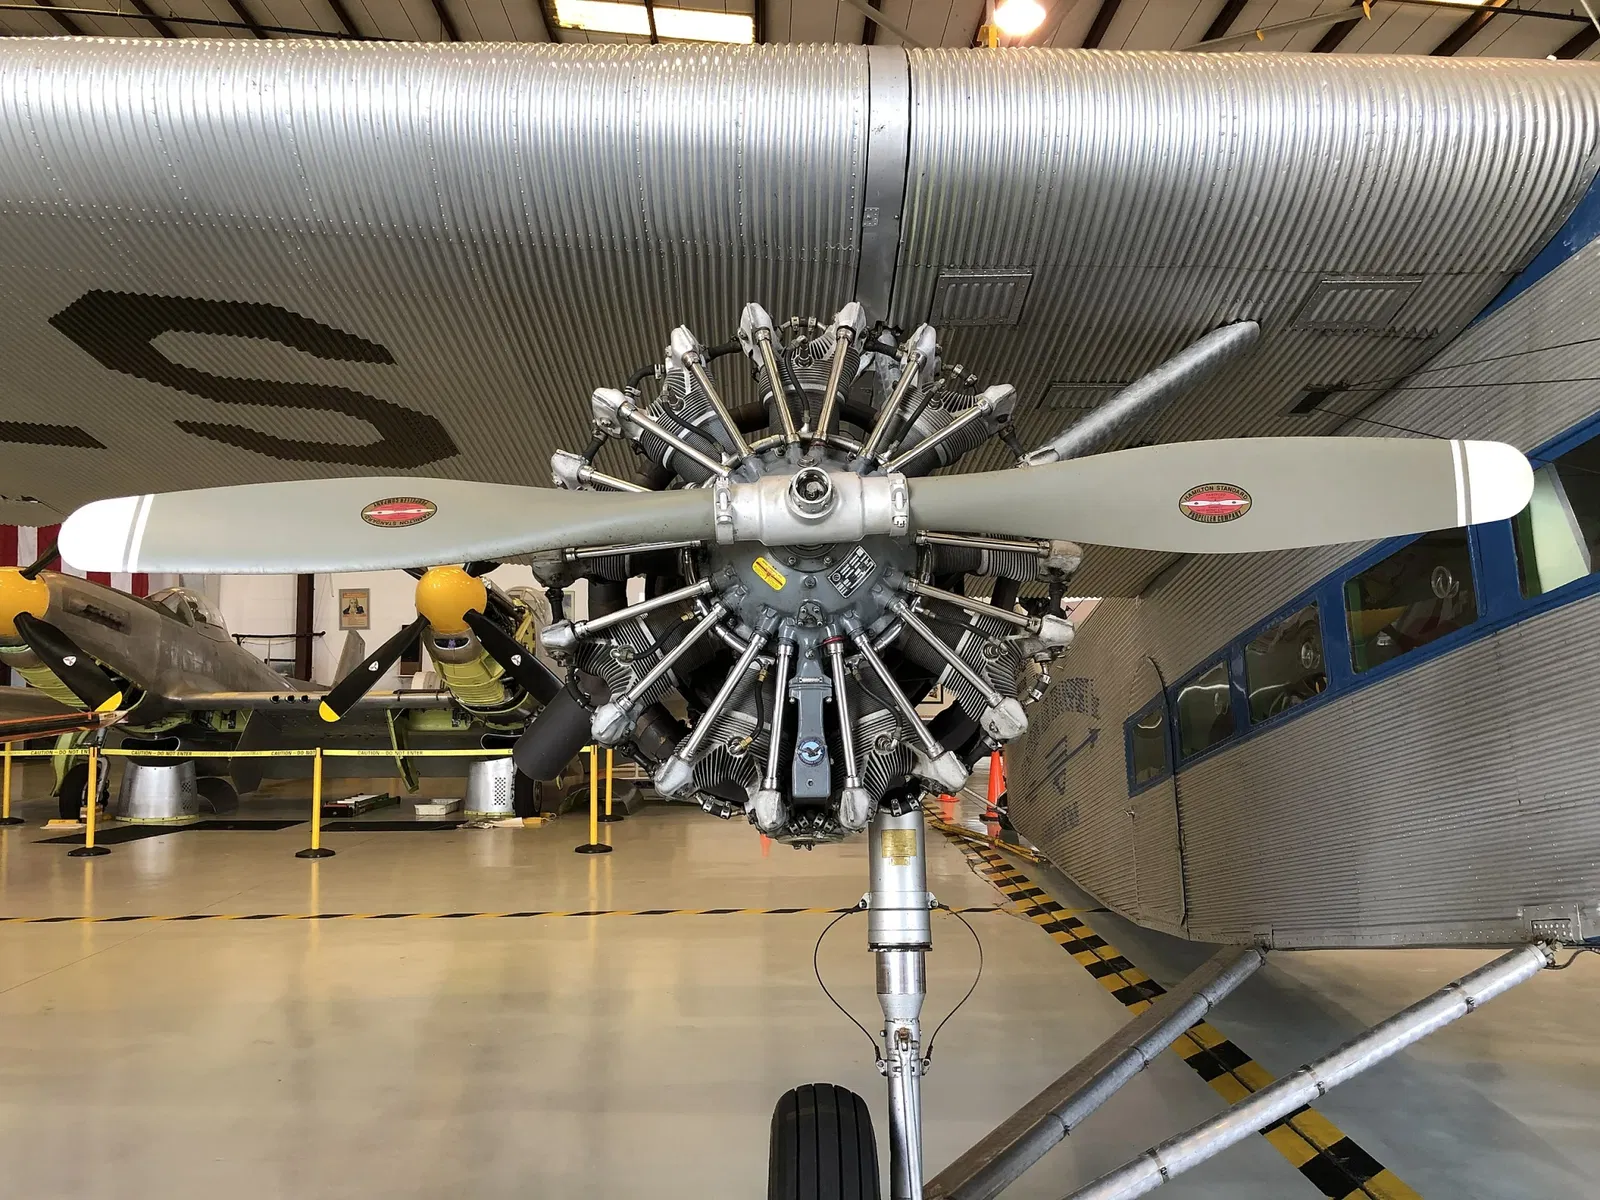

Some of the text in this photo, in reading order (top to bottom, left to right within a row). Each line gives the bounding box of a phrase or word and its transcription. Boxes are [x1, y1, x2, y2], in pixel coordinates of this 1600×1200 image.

[1184, 485, 1248, 501] HAMILTON STANDARD
[364, 512, 431, 526] HAMILTON STANDARD
[1188, 510, 1242, 522] PROPELLER COMPANY
